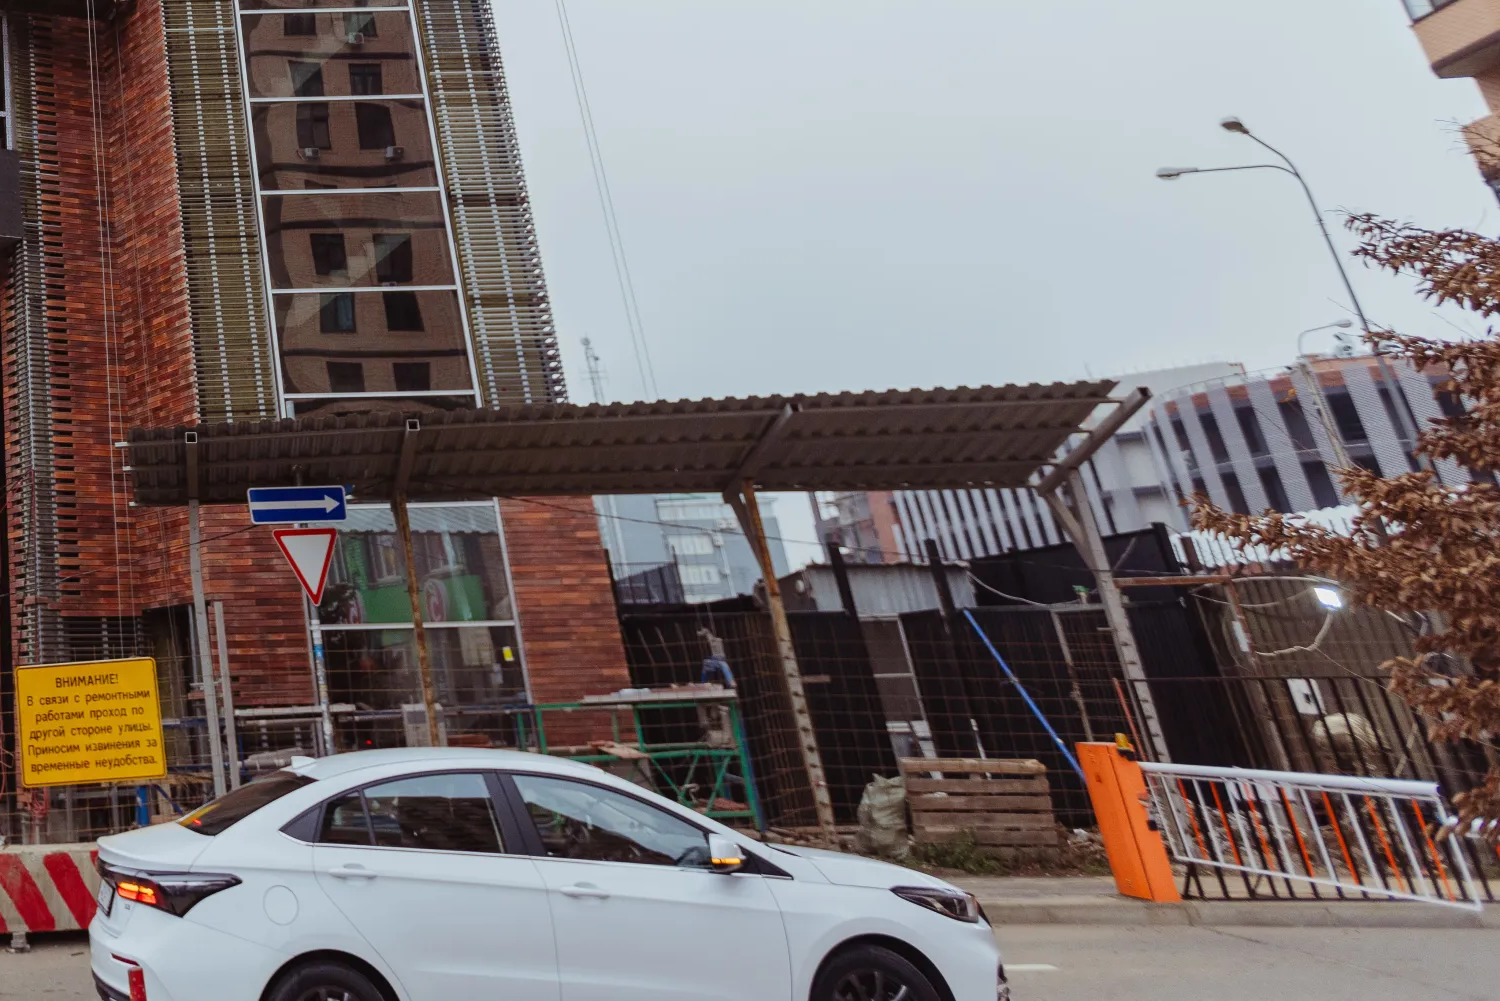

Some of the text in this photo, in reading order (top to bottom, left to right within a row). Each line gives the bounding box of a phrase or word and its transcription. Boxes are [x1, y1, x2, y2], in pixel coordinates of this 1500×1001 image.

[56, 674, 118, 688] ВНИМАНИЕ!
[27, 691, 150, 706] В связи с ремонтными
[36, 707, 144, 724] работами проход по
[29, 724, 152, 741] другой стороне улицы.
[27, 739, 157, 757] Приносим извинения за
[31, 754, 157, 774] временные неудобства.
